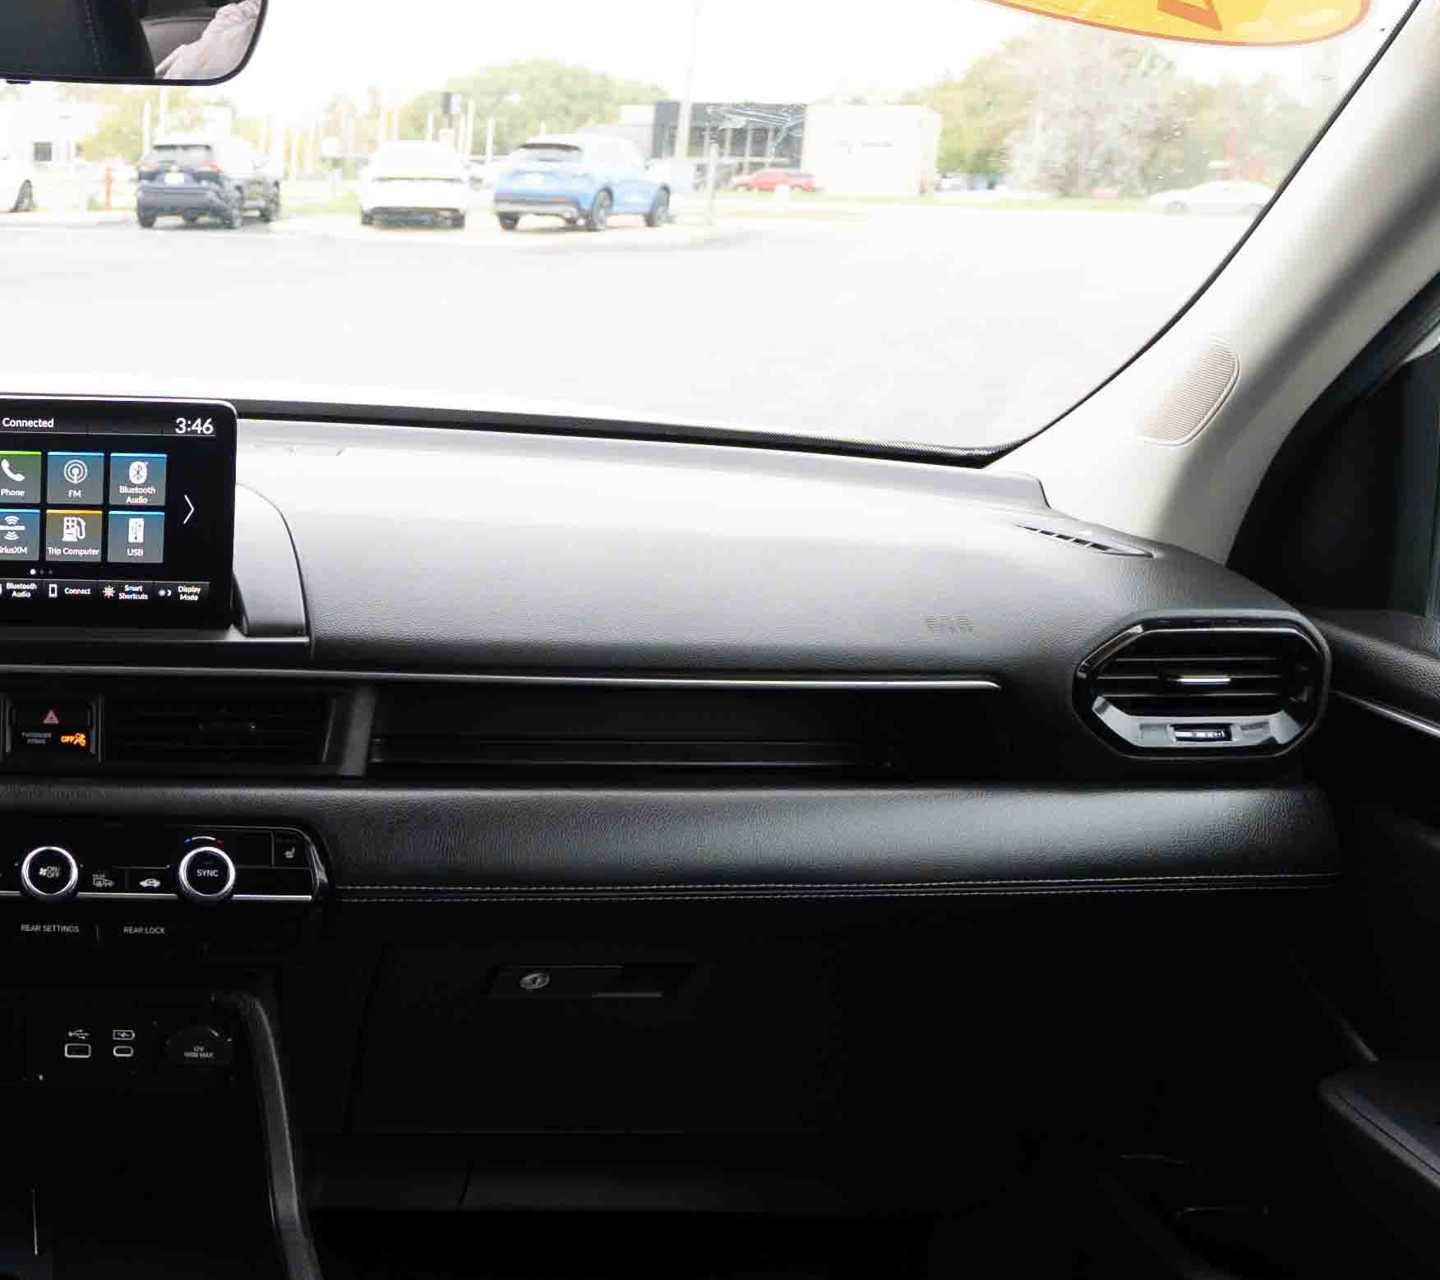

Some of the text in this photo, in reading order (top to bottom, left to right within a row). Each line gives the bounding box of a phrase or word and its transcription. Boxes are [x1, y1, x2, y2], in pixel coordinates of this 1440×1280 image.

[2, 417, 55, 428] Connected
[175, 417, 214, 434] 3:46
[0, 488, 25, 497] Phone
[68, 490, 82, 498] FM
[119, 485, 156, 495] Bluetooth
[125, 495, 149, 505] Audio
[47, 547, 100, 557] Trip Computer
[127, 548, 144, 557] USB
[6, 582, 37, 591] Bluetooth
[64, 587, 92, 596] Connect
[11, 590, 31, 598] Audio
[195, 868, 220, 878] SYNC
[21, 923, 80, 934] REAR SETTINGS
[122, 926, 166, 936] REAR LOCK
